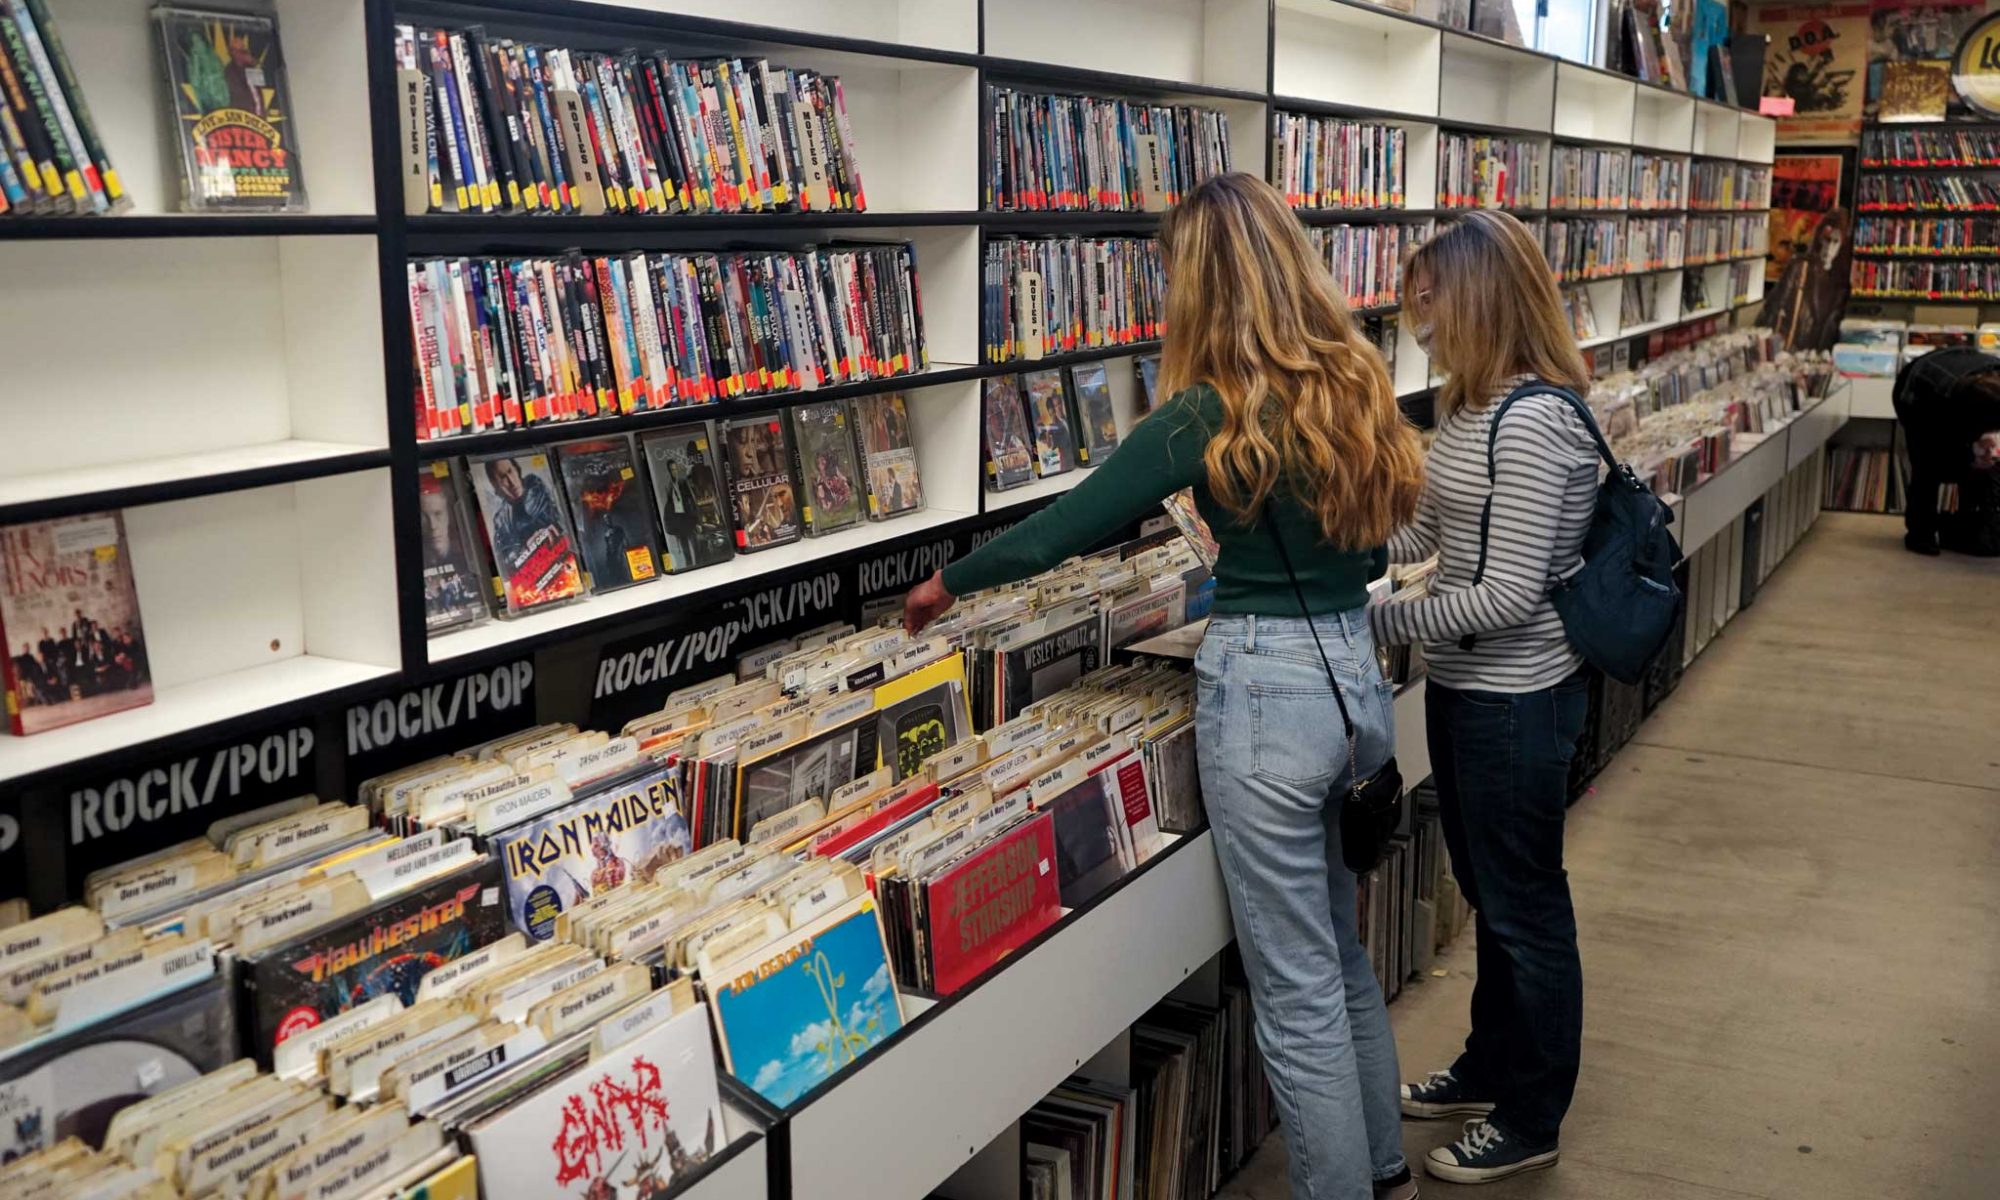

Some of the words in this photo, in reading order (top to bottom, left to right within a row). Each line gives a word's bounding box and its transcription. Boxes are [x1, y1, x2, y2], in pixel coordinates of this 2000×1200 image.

[408, 81, 420, 155] MOVIES
[206, 126, 268, 150] SISTER
[426, 113, 437, 159] VALOR
[567, 100, 589, 165] MOVIES
[585, 171, 592, 182] B
[722, 110, 738, 159] BREACH
[803, 111, 818, 166] MOVIES
[814, 172, 821, 181] C
[194, 145, 288, 168] NANCY
[413, 163, 420, 175] A
[798, 268, 809, 309] DANCE
[806, 310, 817, 340] FLICK
[1029, 279, 1042, 324] MOVIES
[536, 319, 546, 351] CLICK
[724, 461, 740, 522] CELLULAR
[736, 474, 789, 493] CELLULAR
[858, 539, 955, 596] ROCK/POP
[595, 621, 740, 699] ROCK/POP
[904, 648, 917, 659] Lenny
[917, 643, 931, 654] Kravitz
[1024, 639, 1055, 671] WESLEY
[1056, 626, 1088, 657] SCHULTZ
[347, 660, 533, 756] ROCK/POP
[772, 706, 783, 717] Joy
[783, 705, 789, 714] of
[651, 722, 673, 735] Kansas
[714, 733, 730, 746] JOY
[749, 738, 766, 750] Grace
[767, 731, 783, 744] Jones
[990, 762, 1006, 777] KINGS
[1007, 759, 1014, 769] OF
[1014, 753, 1028, 767] LEON
[1037, 774, 1051, 789] Carole
[1051, 769, 1062, 782] King
[70, 726, 314, 846] ROCK/POP
[487, 778, 516, 797] Beautiful
[517, 774, 530, 788] Day
[496, 801, 518, 816] IRON
[519, 788, 552, 807] MAIDEN
[948, 807, 959, 819] Joan
[959, 801, 969, 812] Jett
[994, 806, 1005, 817] Mary
[275, 831, 294, 848] Jimi
[296, 821, 330, 842] Hendrix
[507, 820, 583, 878] IRON
[583, 776, 683, 845] MAIDEN
[816, 833, 830, 846] Elton
[831, 826, 842, 837] John
[899, 833, 909, 845] Tull
[394, 862, 413, 878] HEAD
[414, 858, 427, 871] AND
[428, 853, 440, 867] THE
[952, 831, 1038, 919] JEFFERSON
[120, 883, 139, 901] Don
[142, 874, 177, 894] Henley
[959, 875, 1036, 953] STARSHIP
[12, 961, 59, 987] Grateful
[64, 948, 94, 968] Dead
[104, 953, 144, 974] Railroad
[431, 967, 458, 988] Richie
[460, 953, 489, 974] Havens
[560, 1000, 583, 1018] Steve
[622, 1007, 654, 1032] GWAR
[552, 1054, 669, 1188] GWAR
[315, 1132, 365, 1167] Gallagher
[353, 1150, 390, 1179] Gabriel
